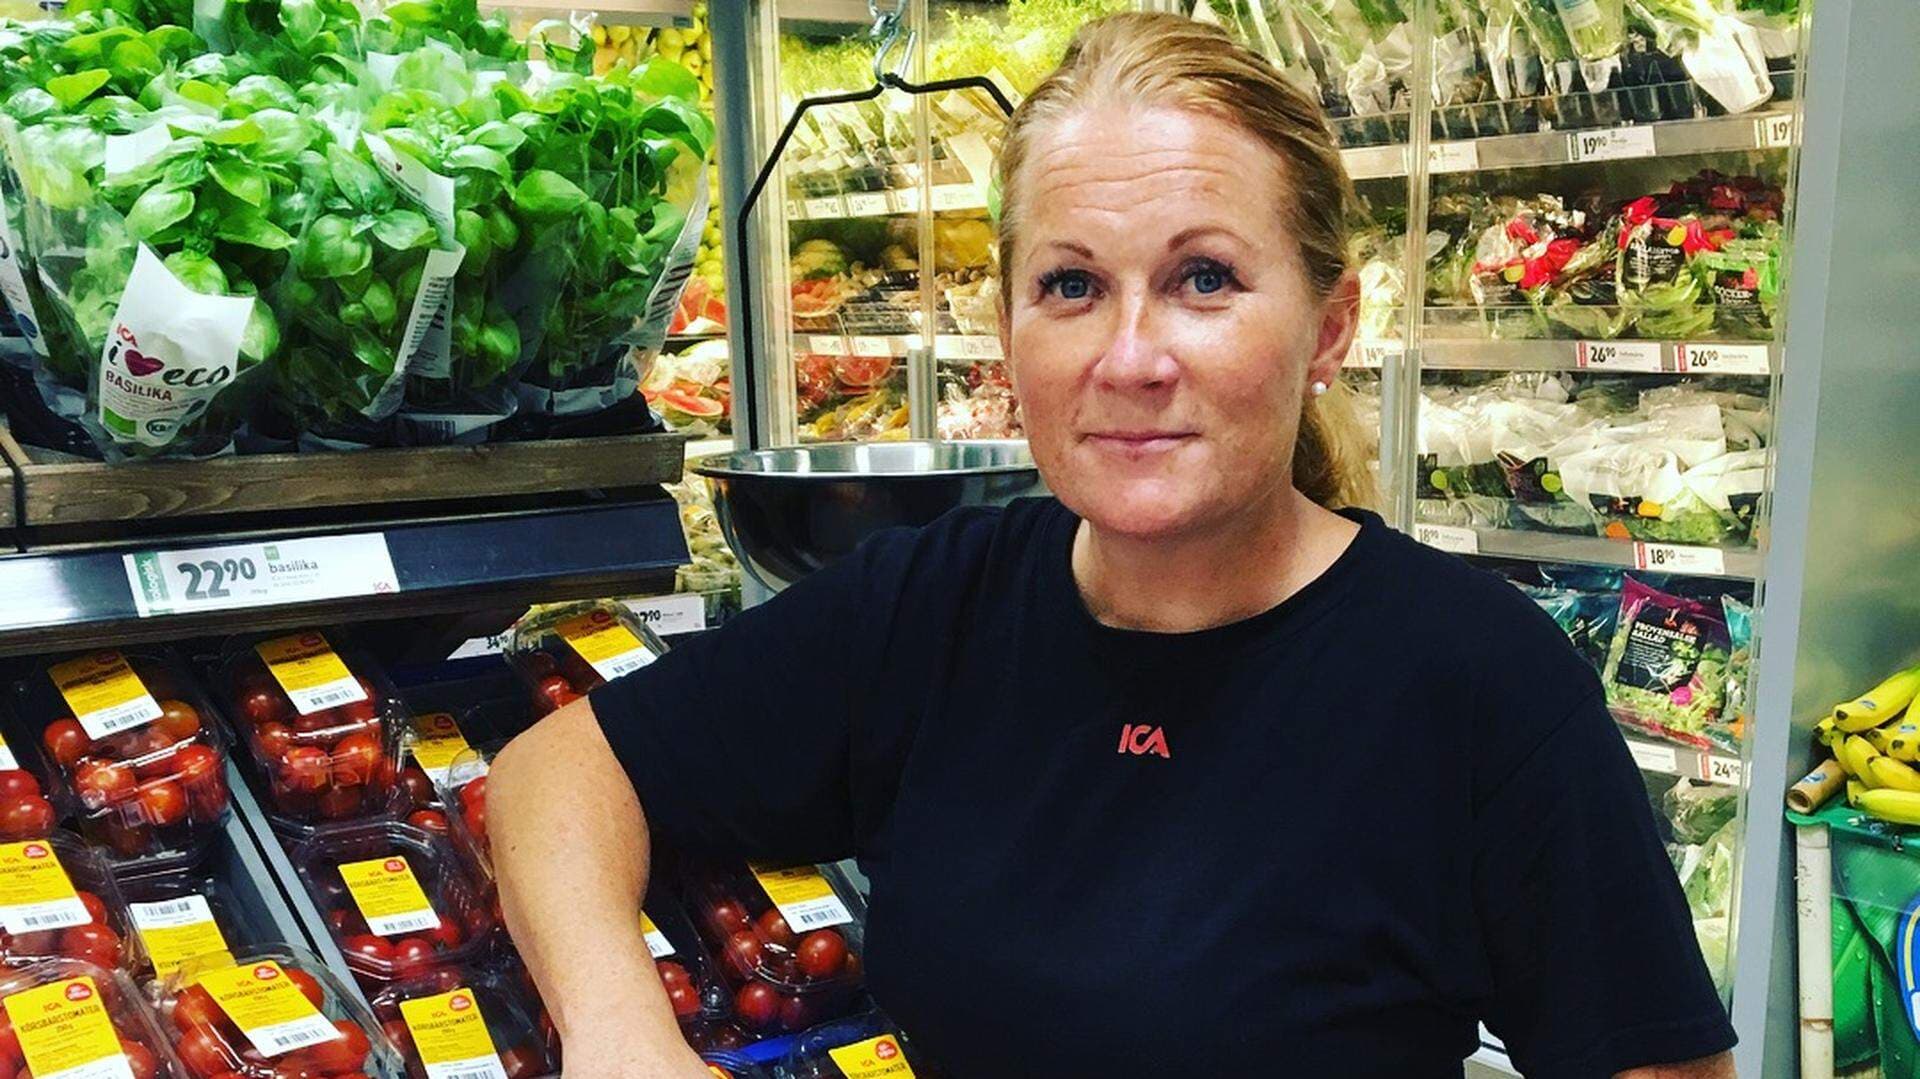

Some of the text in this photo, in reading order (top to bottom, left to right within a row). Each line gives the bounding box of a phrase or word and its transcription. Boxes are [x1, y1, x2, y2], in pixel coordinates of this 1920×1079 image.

[1590, 345, 1617, 363] 2690
[1690, 350, 1719, 367] 2690
[105, 369, 173, 402] BASILIKA
[162, 365, 230, 388] eco
[268, 559, 319, 574] basilika
[1650, 548, 1676, 565] 1890
[176, 556, 257, 601] 2290
[1117, 724, 1171, 759] ICA
